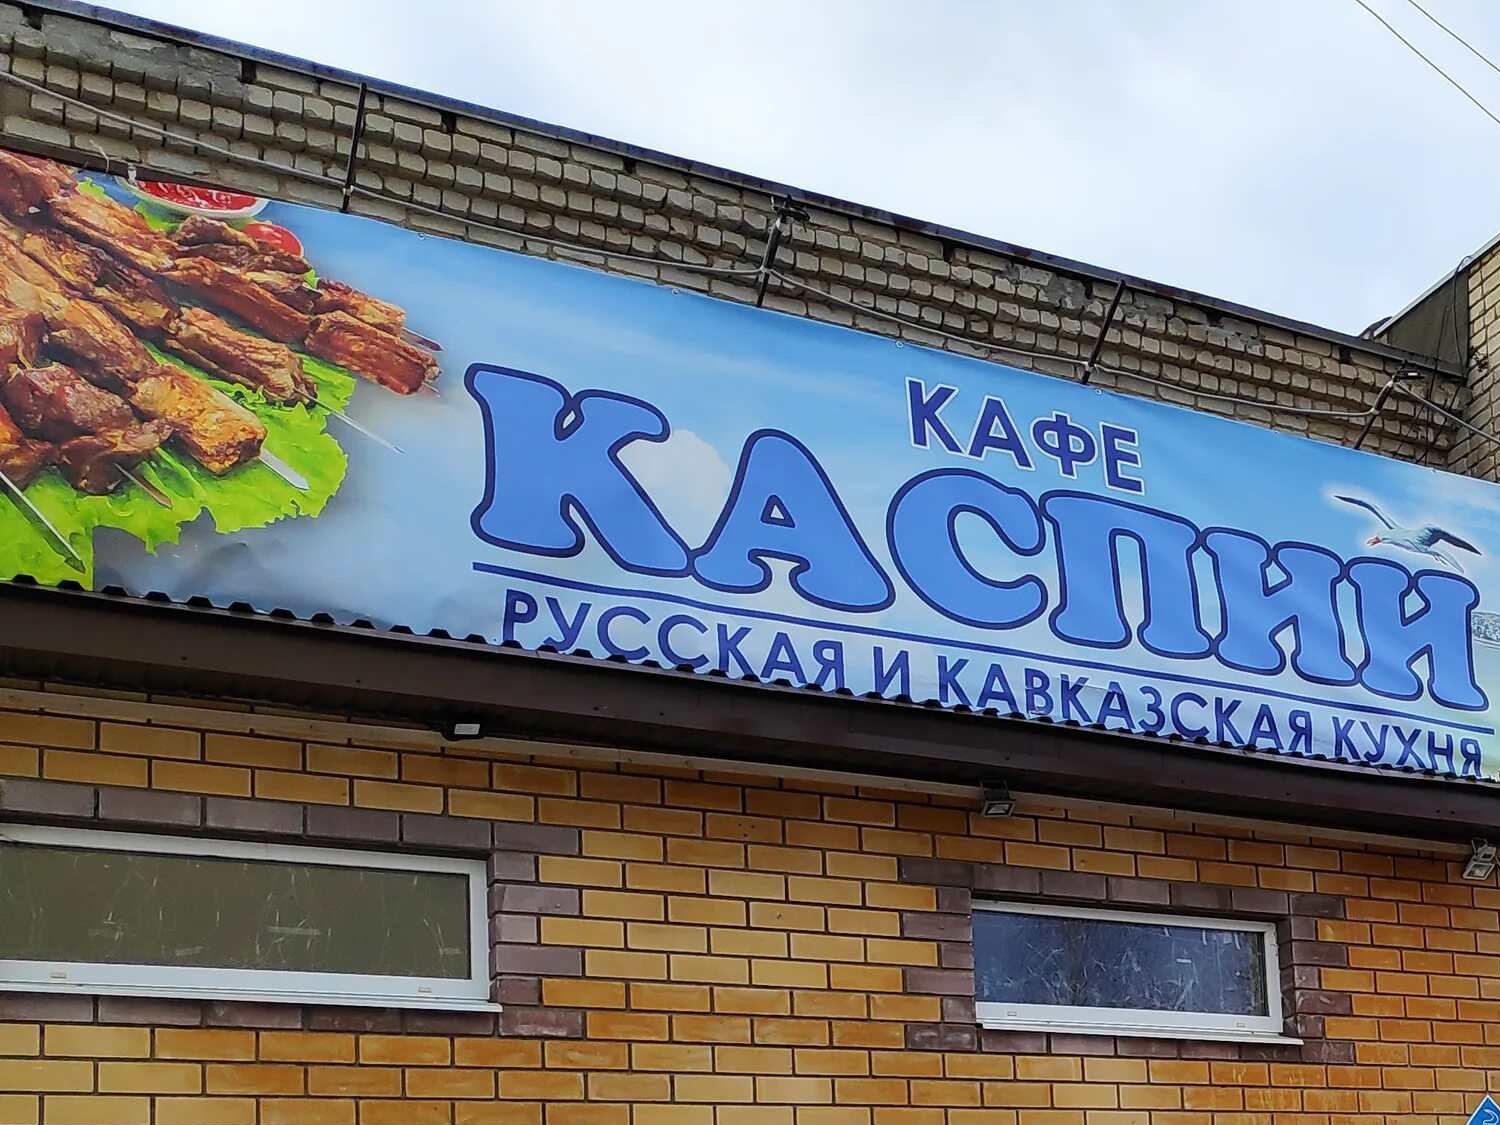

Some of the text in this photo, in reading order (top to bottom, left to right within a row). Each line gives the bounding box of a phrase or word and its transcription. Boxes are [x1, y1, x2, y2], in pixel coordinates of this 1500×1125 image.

[906, 378, 1145, 494] КАФЕ
[502, 588, 1482, 776] РУССКАЯ И КАВКАЗСКАЯ КУХНЯ
